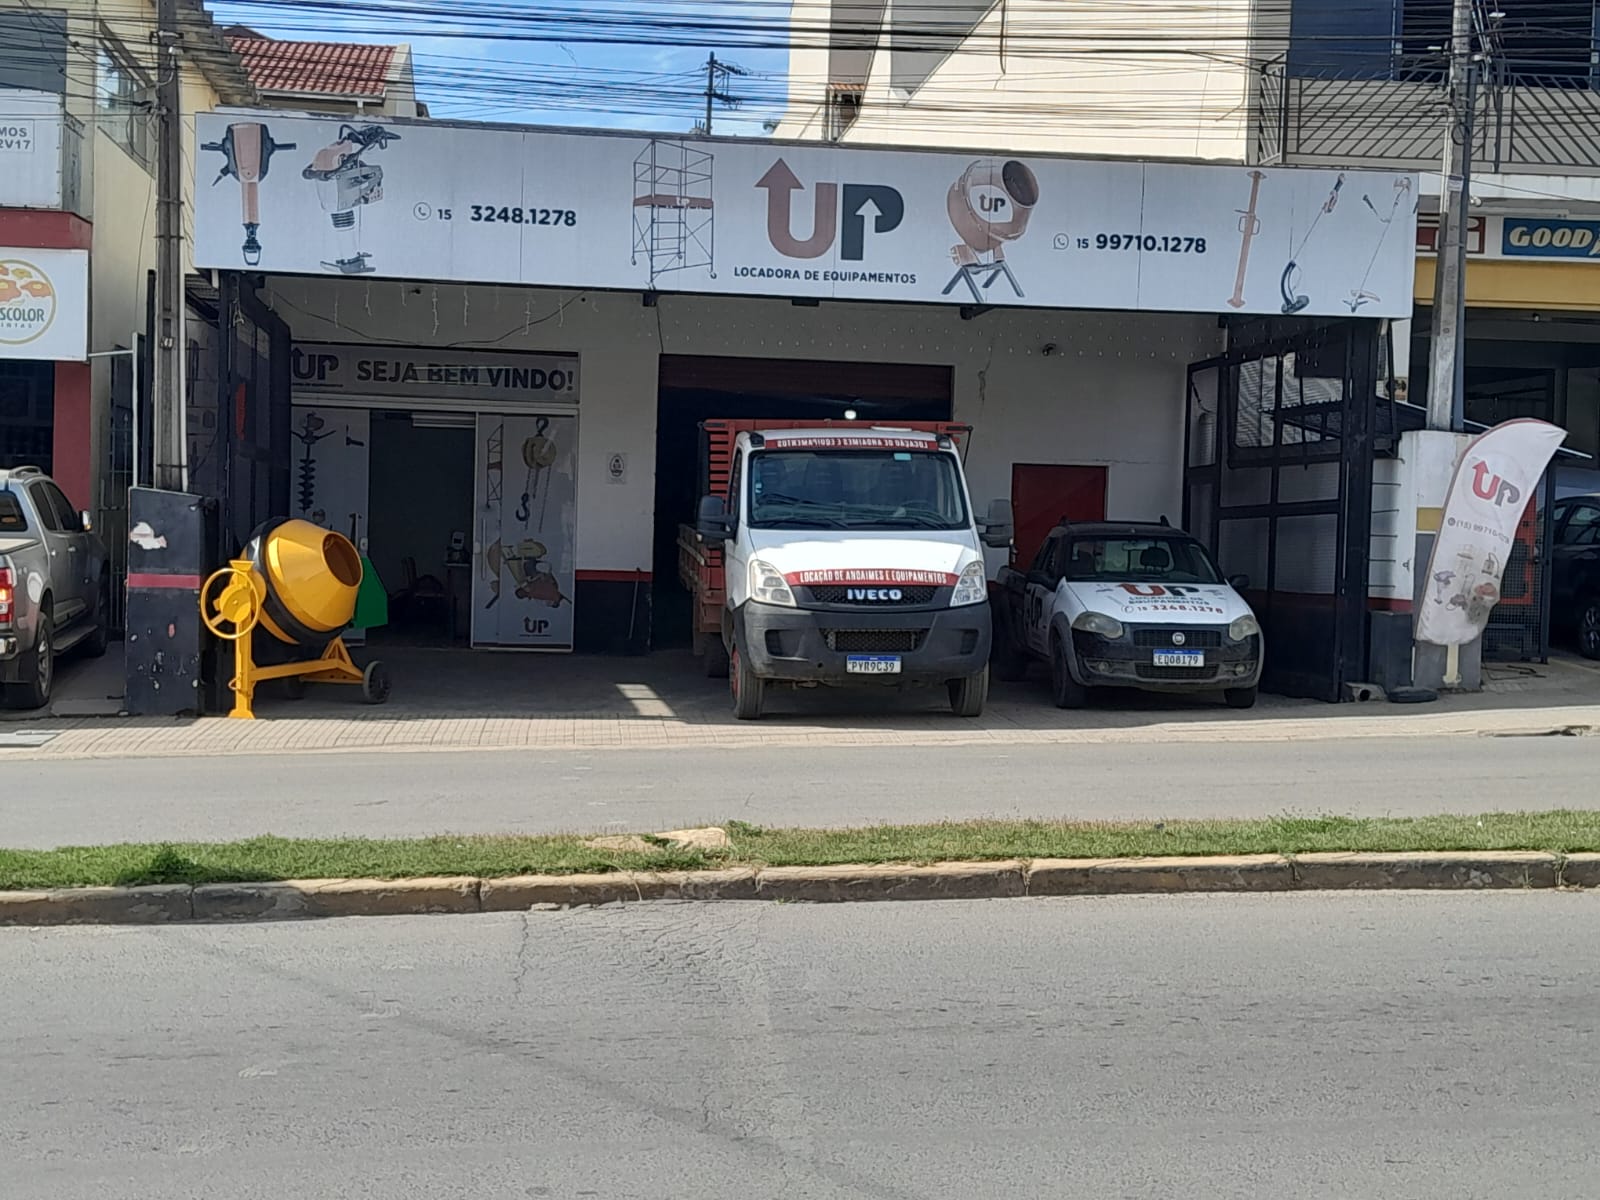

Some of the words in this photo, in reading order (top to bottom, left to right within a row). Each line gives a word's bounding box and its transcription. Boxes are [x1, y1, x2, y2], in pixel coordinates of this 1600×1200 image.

[753, 157, 905, 261] UP
[978, 193, 1006, 213] UP
[437, 208, 453, 221] 15
[469, 204, 577, 227] 3248.1278
[1076, 238, 1090, 250] 15
[1095, 232, 1207, 254] 99710.1278
[733, 266, 801, 280] LOCADORA
[804, 270, 820, 281] DE
[823, 270, 917, 284] EQUIPAMENTOS
[290, 347, 340, 380] UP
[356, 360, 419, 383] SEJA
[427, 363, 480, 387] BEM
[487, 367, 574, 392] VINDO!
[1471, 460, 1521, 507] UP
[847, 589, 902, 600] IVECO
[1117, 583, 1200, 597] UP
[524, 616, 550, 634] UP
